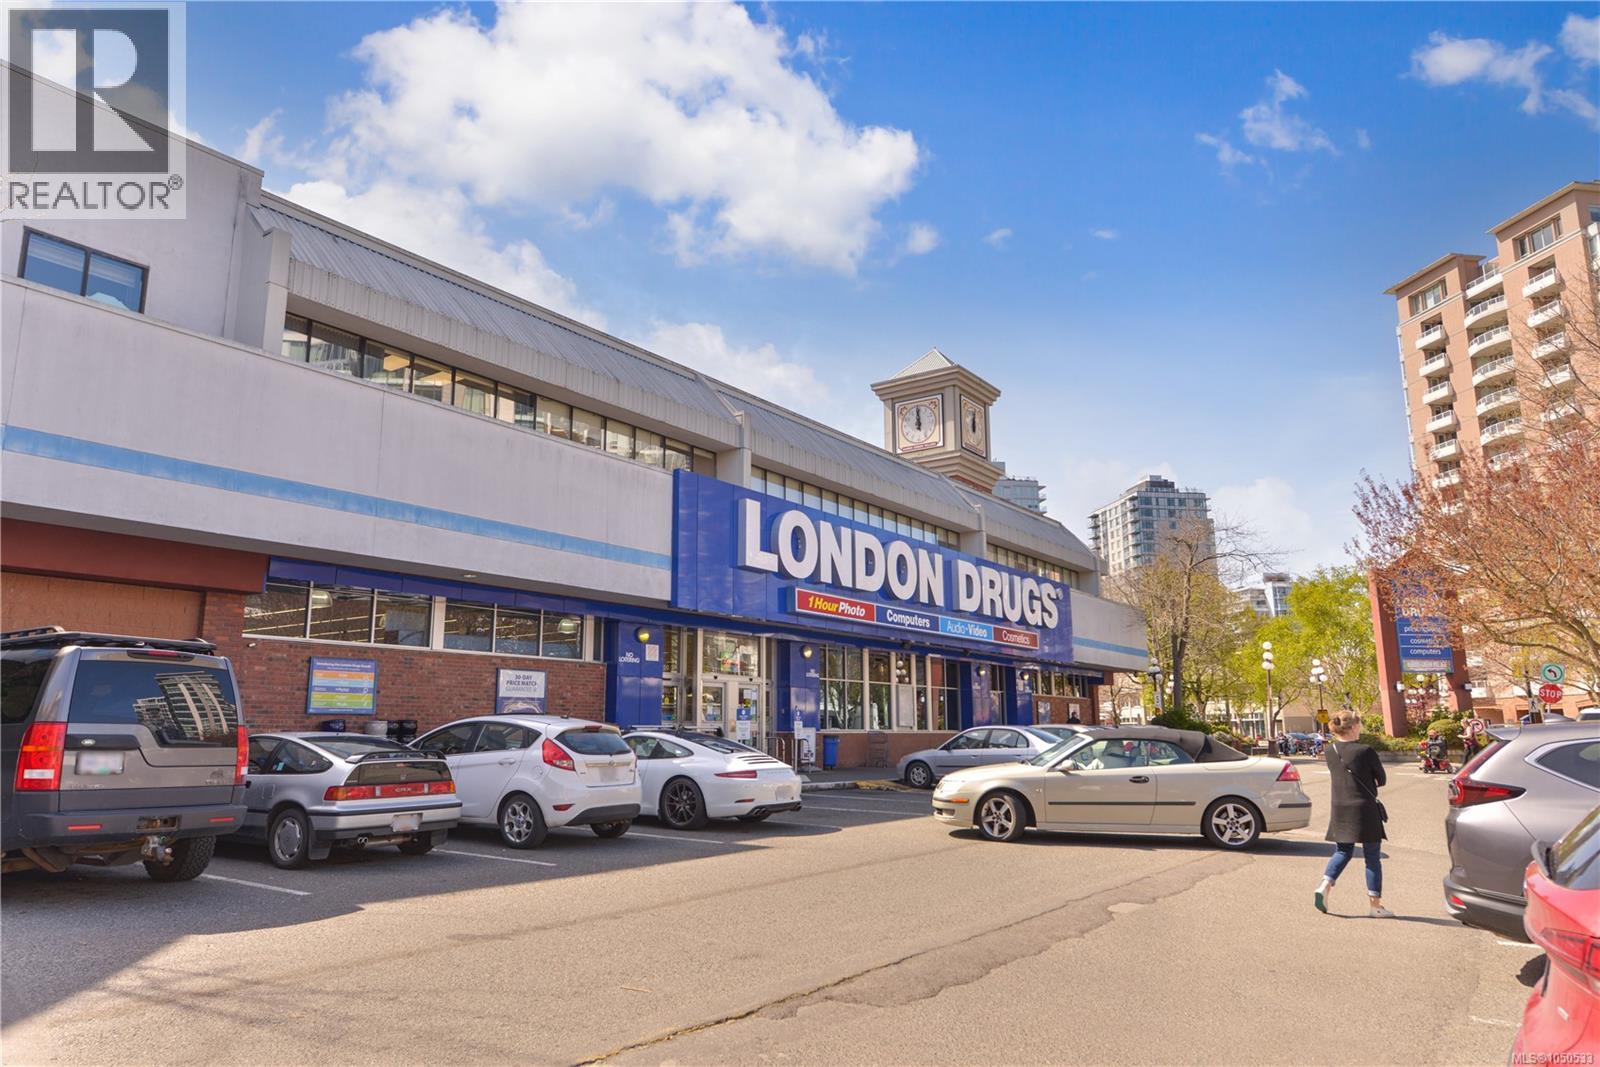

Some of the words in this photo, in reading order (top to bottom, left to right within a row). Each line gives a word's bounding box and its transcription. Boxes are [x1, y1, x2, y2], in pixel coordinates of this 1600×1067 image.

[739, 499, 944, 607] LONDON
[814, 597, 838, 611] Hour
[839, 601, 866, 617] Photo
[886, 609, 930, 628] Computers
[1002, 630, 1030, 645] Cosmetics
[1409, 648, 1441, 656] computers
[1539, 688, 1562, 699] STOP
